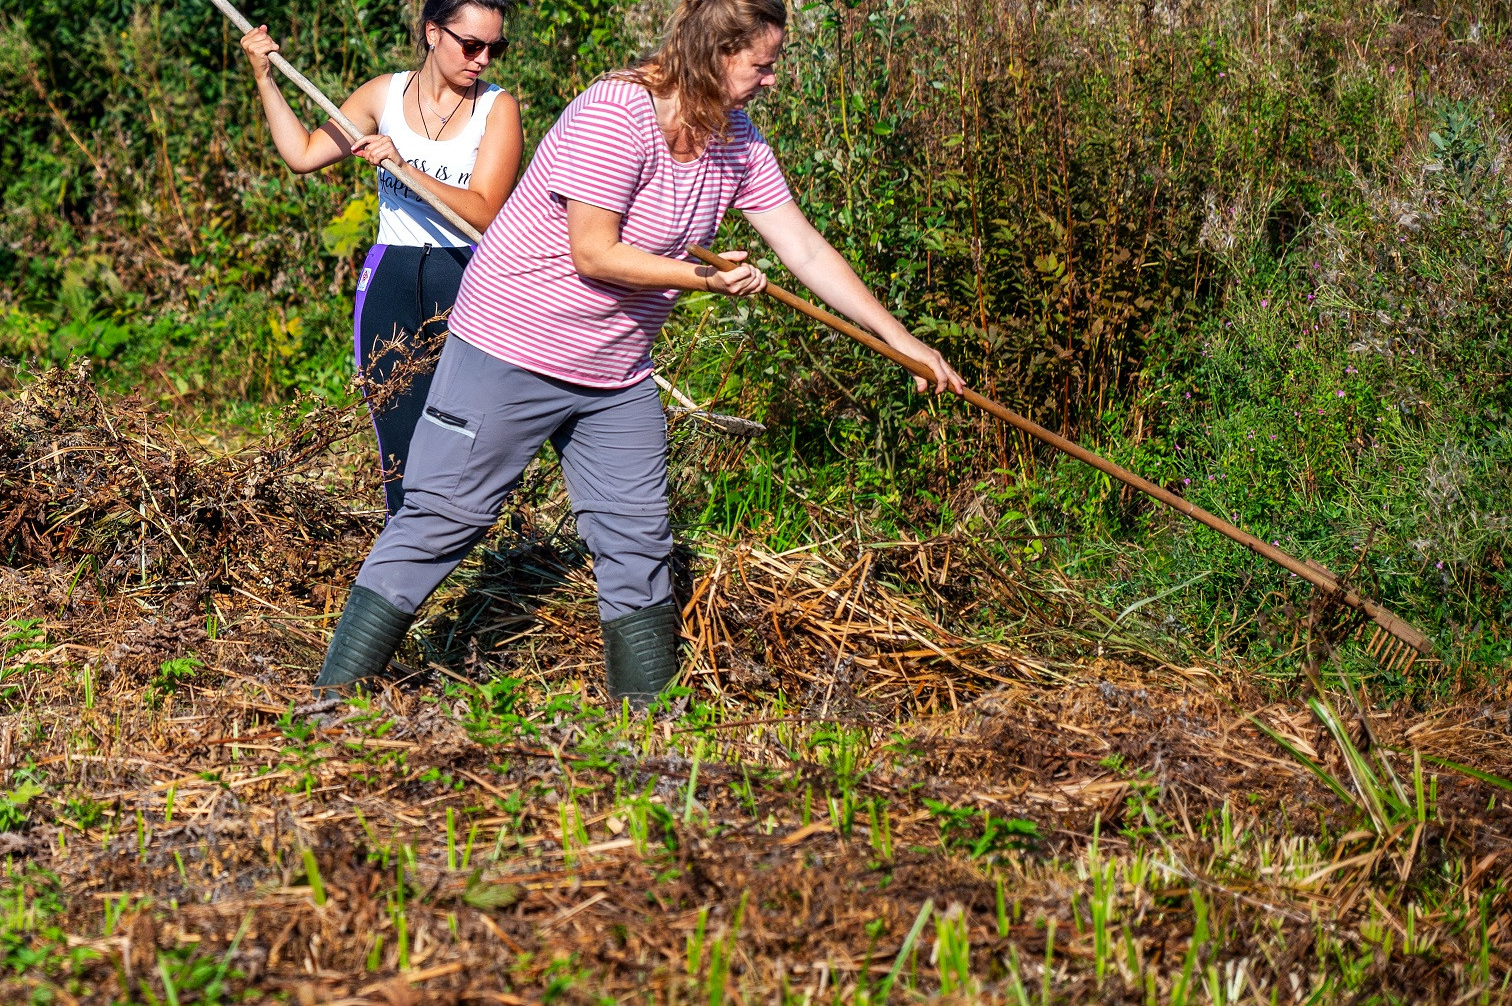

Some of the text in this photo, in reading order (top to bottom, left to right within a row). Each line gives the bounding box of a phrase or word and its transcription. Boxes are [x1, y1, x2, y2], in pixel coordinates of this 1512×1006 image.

[379, 169, 423, 203] Happ
[435, 165, 452, 181] is
[457, 172, 472, 185] m
